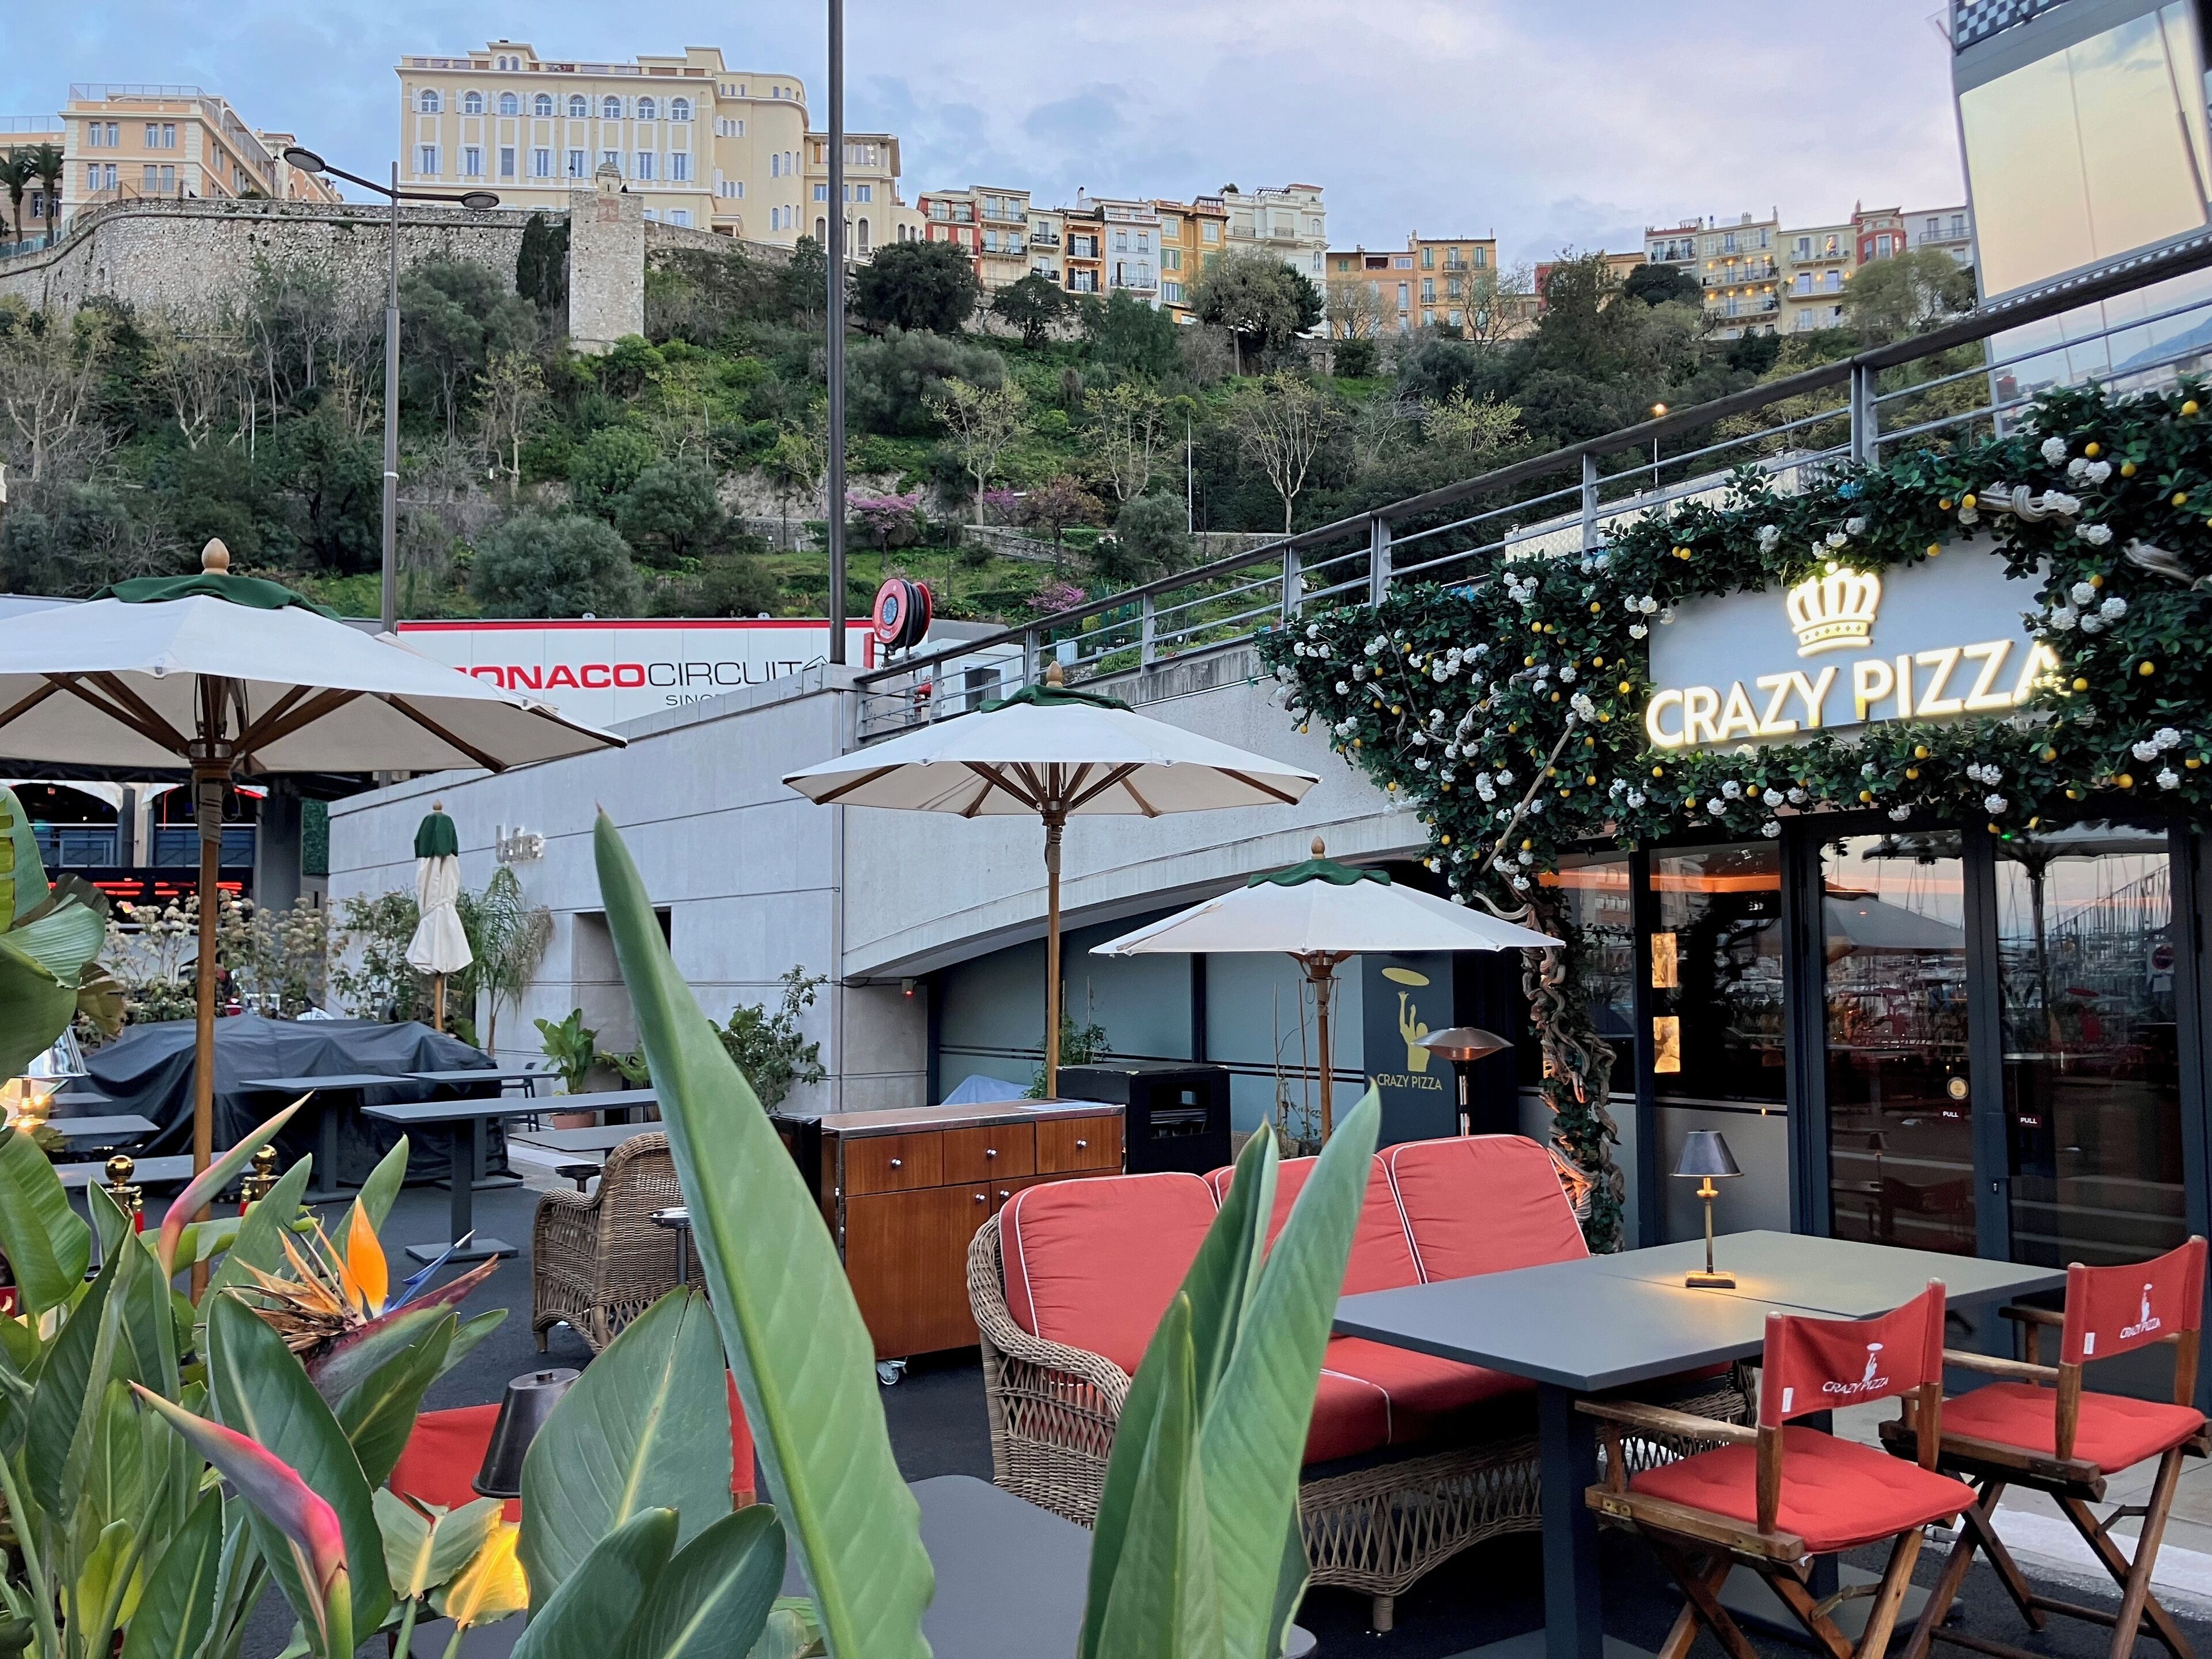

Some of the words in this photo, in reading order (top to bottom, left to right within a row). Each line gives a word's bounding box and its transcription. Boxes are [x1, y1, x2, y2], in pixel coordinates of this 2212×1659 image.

[1645, 666, 1839, 748] CRAZY
[1853, 639, 2069, 721] PIZZA
[1377, 1073, 1410, 1088] CRAZY
[1411, 1075, 1442, 1090] PIZZA
[1822, 1381, 1863, 1394] CRAZY
